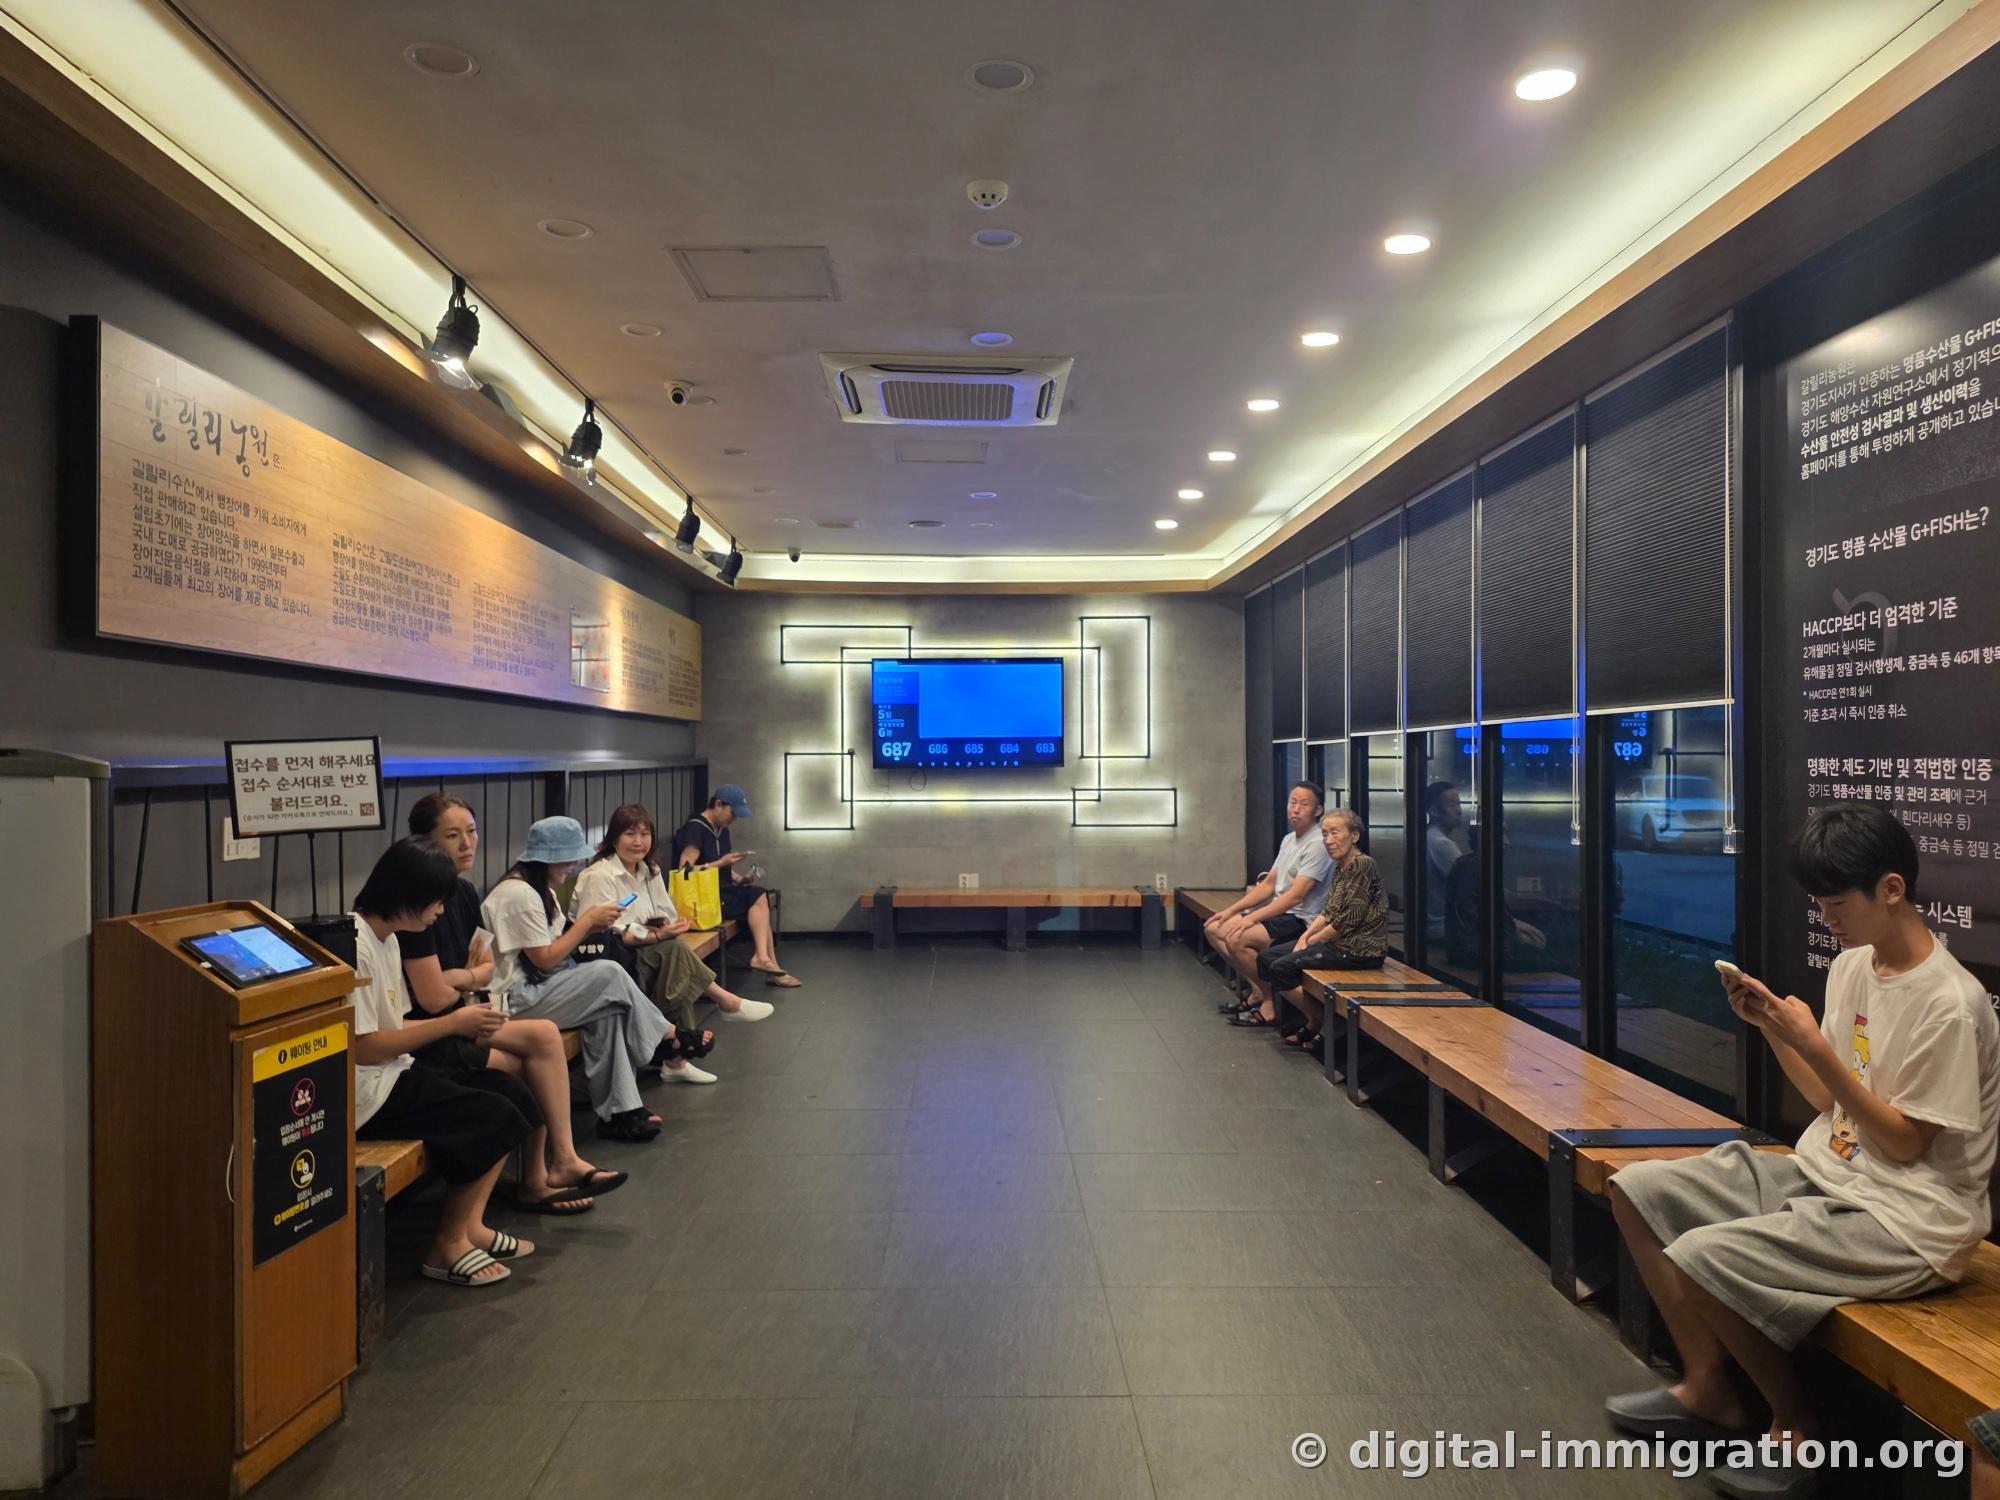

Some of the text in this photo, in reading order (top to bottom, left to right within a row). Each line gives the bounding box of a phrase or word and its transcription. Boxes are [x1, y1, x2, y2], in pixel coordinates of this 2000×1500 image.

[1801, 382, 1856, 416] 경기도지사가
[1859, 363, 1900, 392] 인증하는
[1903, 333, 1962, 374] 명품수산물
[1801, 358, 1856, 396] 갈릴리농원은
[1801, 416, 1829, 438] 경기도
[1830, 397, 1870, 425] 해양수산
[1872, 364, 1949, 407] 자원연구소에서
[1801, 377, 1982, 460] 수산물 안전성 검사결과 및 생산이력을
[1801, 450, 1847, 481] 홈페이지를
[1849, 442, 1870, 465] 통해
[1872, 425, 1915, 455] 투명하게
[1917, 410, 1965, 441] 공개하고
[132, 482, 153, 504] 직접
[158, 490, 196, 516] 판매하고
[132, 503, 193, 536] 설립초기에는
[244, 537, 267, 557] 하면서
[1805, 506, 1989, 569] 경기도 명품 수산물 G+FISH는?
[132, 522, 153, 544] 국내
[246, 556, 287, 580] 1999년부터
[187, 576, 214, 597] 최고의
[1803, 597, 1958, 638] HACCP보다 더 엄격한 기준
[1803, 638, 1876, 659] 2개월마다 실시되는
[1803, 664, 1835, 681] 유해물질
[1836, 662, 1853, 679] 정밀
[1907, 653, 1938, 671] 중금속
[1940, 651, 1951, 668] 등
[1953, 647, 1980, 665] 46개
[1858, 685, 1872, 698] 실시
[1803, 708, 1820, 723] 기준
[1838, 706, 1847, 721] 시
[1849, 706, 1866, 721] 즉시
[1868, 704, 1886, 720] 인증
[1888, 703, 1908, 719] 취소
[882, 742, 912, 757] 687
[928, 743, 949, 754] 686
[964, 743, 984, 754] 685
[1000, 742, 1019, 754] 684
[1035, 742, 1055, 754] 683
[234, 754, 376, 773] 접수를 먼저 해주세요
[1807, 758, 1992, 781] 명확한 제도 기반 및 적법한 인증
[241, 773, 369, 793] 접수 순서대로 번호
[1807, 783, 1987, 805] 경기도 명품수산물 인증 및 관리 조례에 근거
[270, 794, 348, 812] 불러드려요.
[1902, 809, 1953, 829] 흰다리새우
[1955, 814, 1971, 831] 등)
[1918, 836, 1950, 853] 중금속
[1952, 839, 1964, 856] 등
[1966, 840, 1989, 858] 정밀
[1927, 901, 1972, 929] 시스템
[1807, 931, 1838, 951] 경기도청
[1807, 952, 1835, 971] 갈릴리
[289, 1035, 328, 1061] 웨이팅 안내
